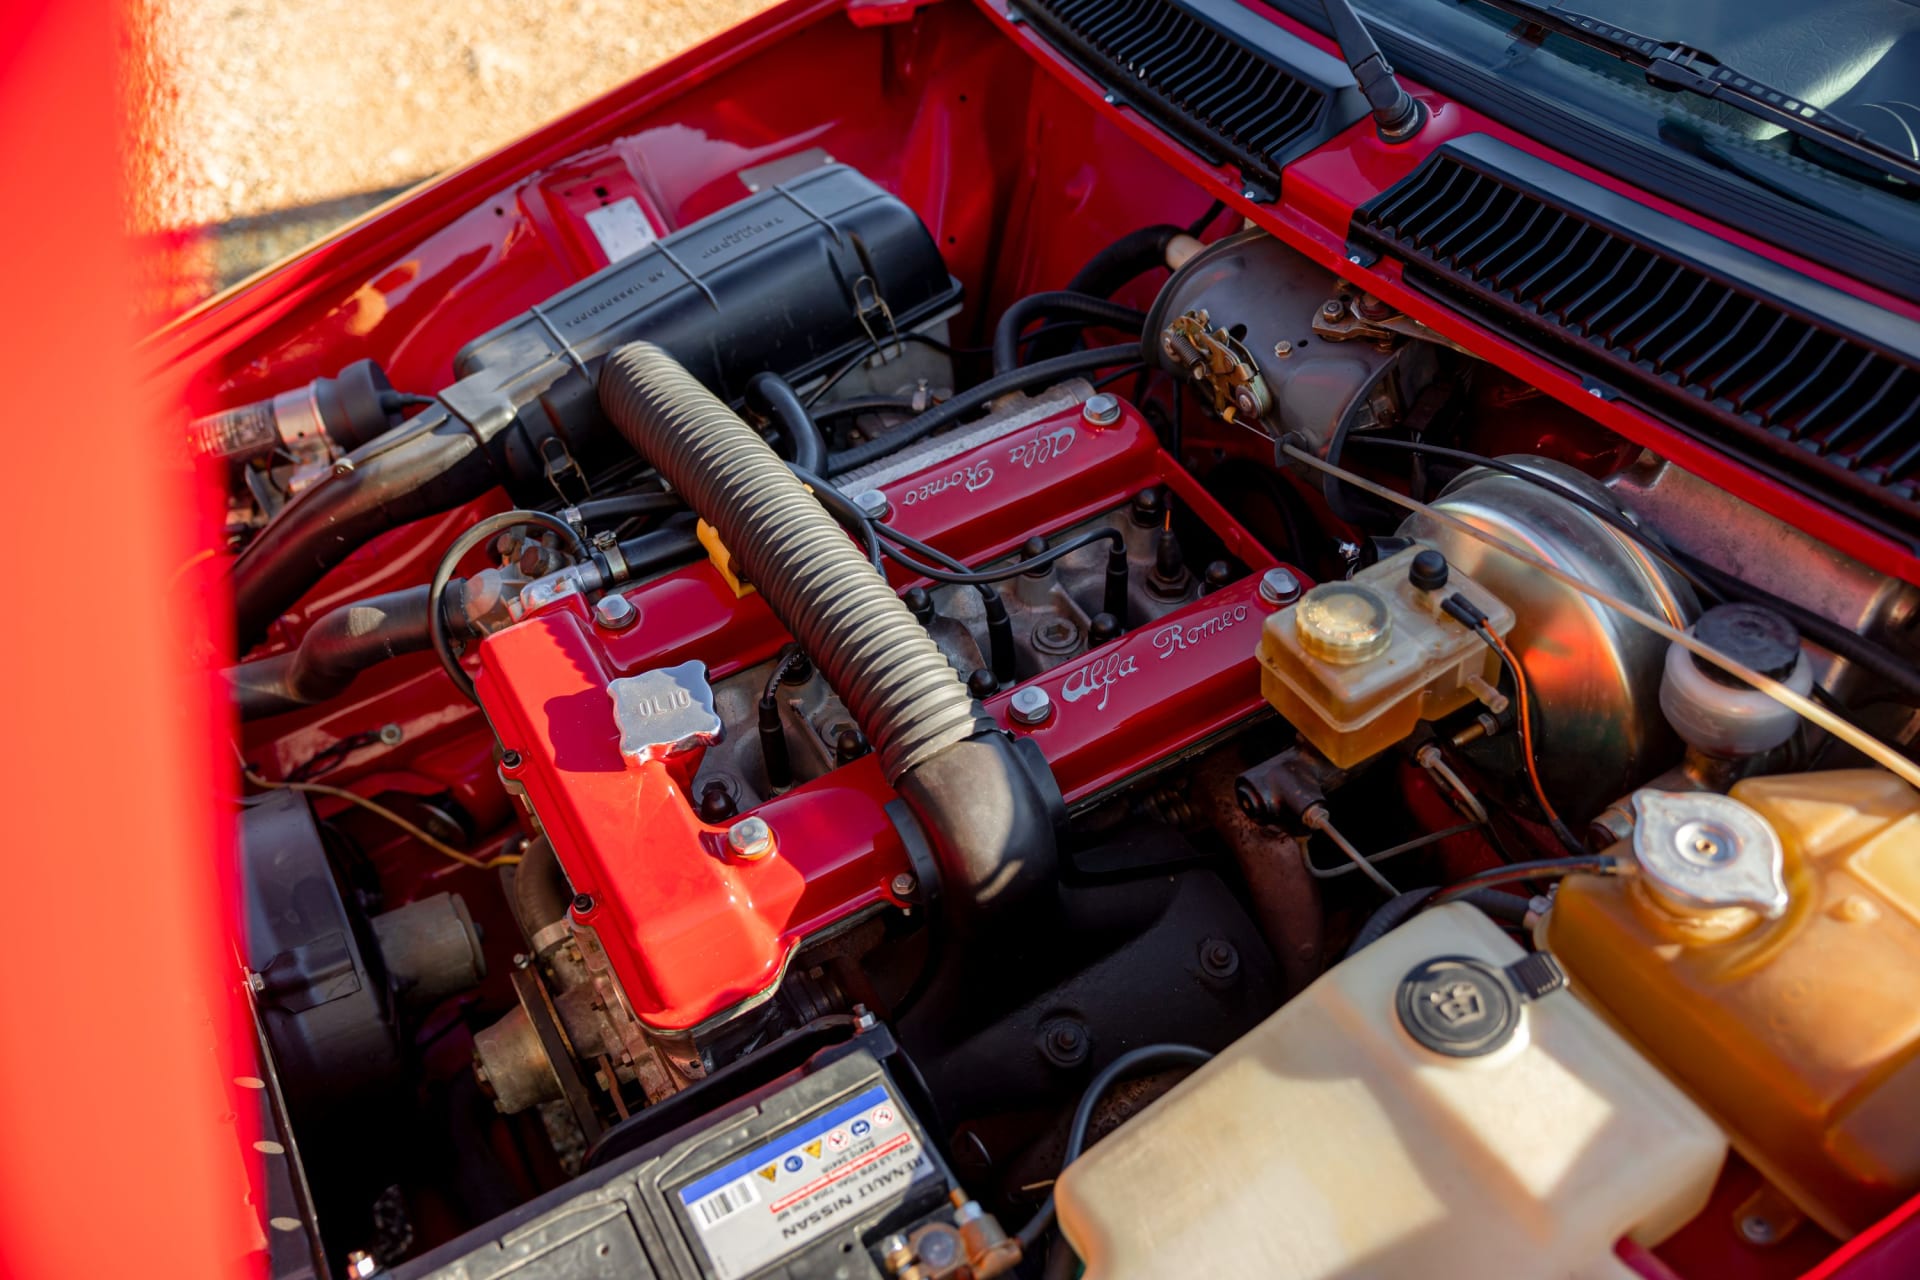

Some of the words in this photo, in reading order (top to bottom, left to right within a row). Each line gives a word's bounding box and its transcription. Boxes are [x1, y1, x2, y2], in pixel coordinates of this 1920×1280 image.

[1008, 425, 1076, 468] Alfa
[902, 459, 994, 506] Romeo
[1061, 652, 1139, 710] Alfa
[1152, 605, 1248, 659] Romeo
[639, 688, 691, 718] OLIO
[858, 1155, 925, 1198] RENAULT
[781, 1193, 853, 1239] NISSAN
